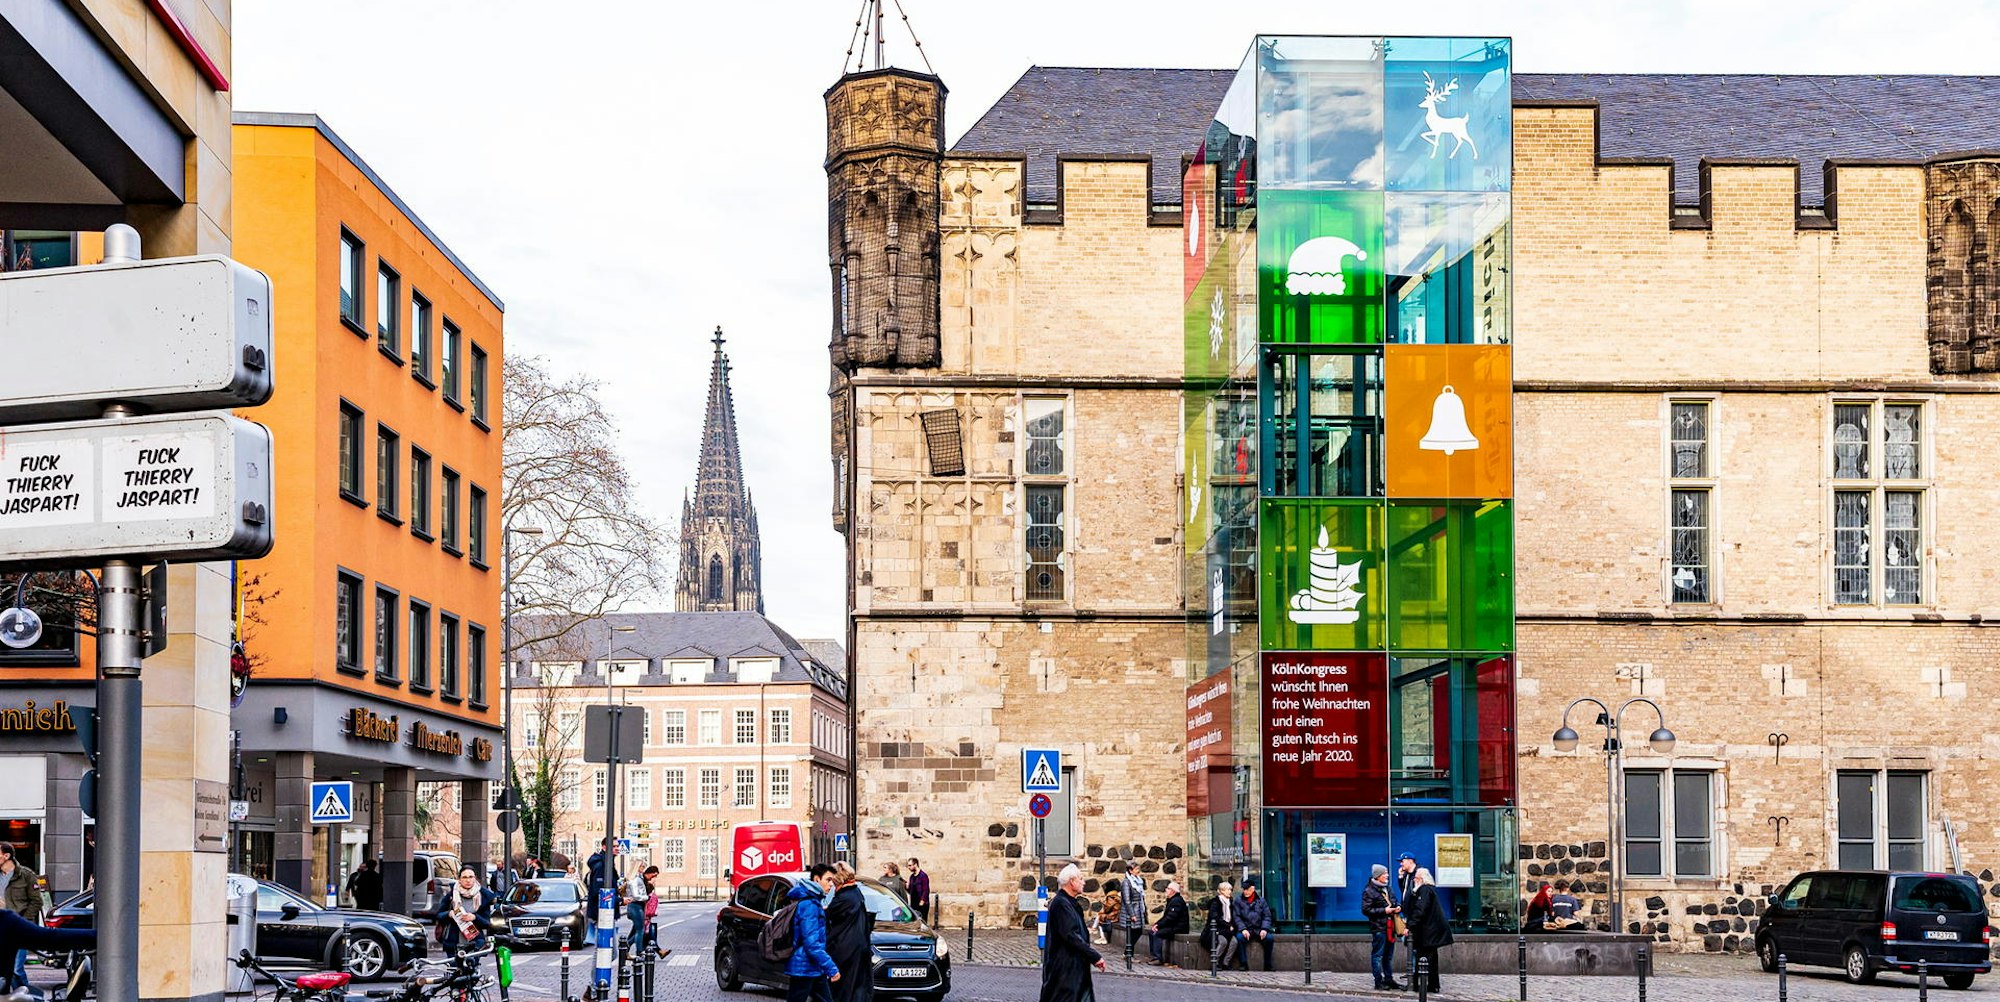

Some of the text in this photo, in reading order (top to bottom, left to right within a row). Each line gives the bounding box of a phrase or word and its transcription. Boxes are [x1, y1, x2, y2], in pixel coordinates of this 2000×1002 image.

[20, 455, 60, 472] FUCK
[138, 448, 180, 465] FUCK
[7, 474, 74, 493] THIERRY
[124, 467, 194, 486] THIERRY
[0, 493, 80, 515] JASPART!
[116, 487, 199, 508] JASPART!
[1272, 663, 1347, 678] KölnKongress
[1271, 680, 1348, 693] wünscht Ihnen
[1272, 697, 1371, 710] frohe Weihnachten
[1272, 715, 1324, 727] und einen
[353, 707, 400, 743] Bäckerei
[415, 721, 463, 756] Merzenich
[1272, 732, 1358, 747] guten Rutsch ins
[1273, 749, 1354, 764] neue Jahr 2020.
[768, 849, 794, 866] dpd
